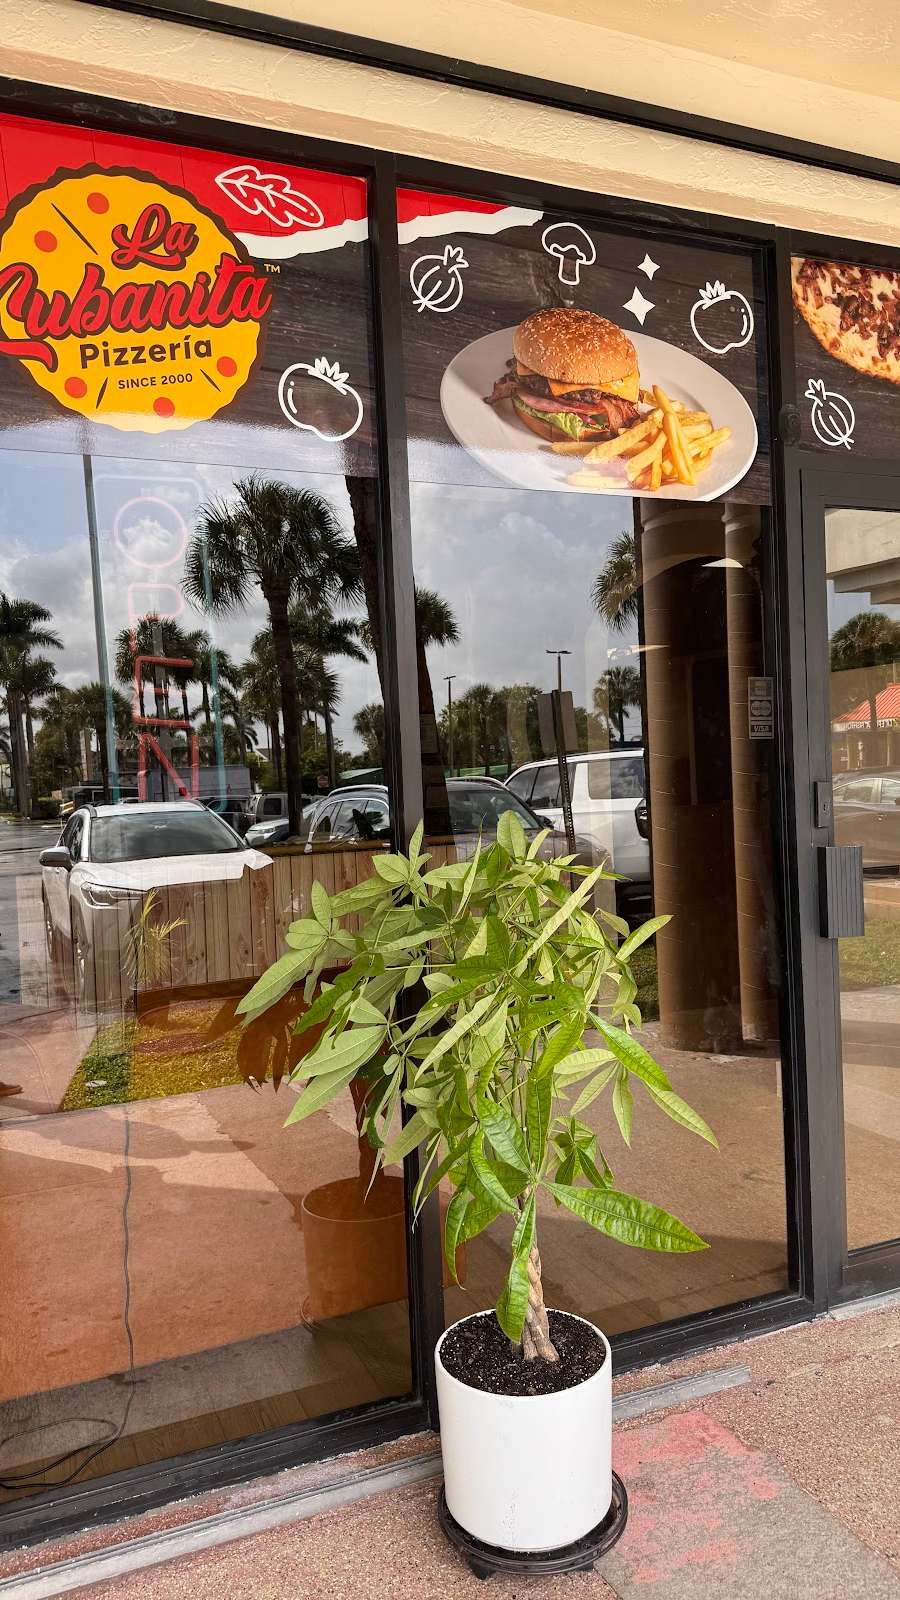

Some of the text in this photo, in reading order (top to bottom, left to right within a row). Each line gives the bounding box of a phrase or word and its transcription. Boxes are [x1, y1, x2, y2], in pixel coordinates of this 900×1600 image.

[111, 203, 199, 271] La
[80, 335, 212, 369] Pizzería
[118, 373, 193, 389] SINCE 2000
[113, 496, 199, 802] OPEN
